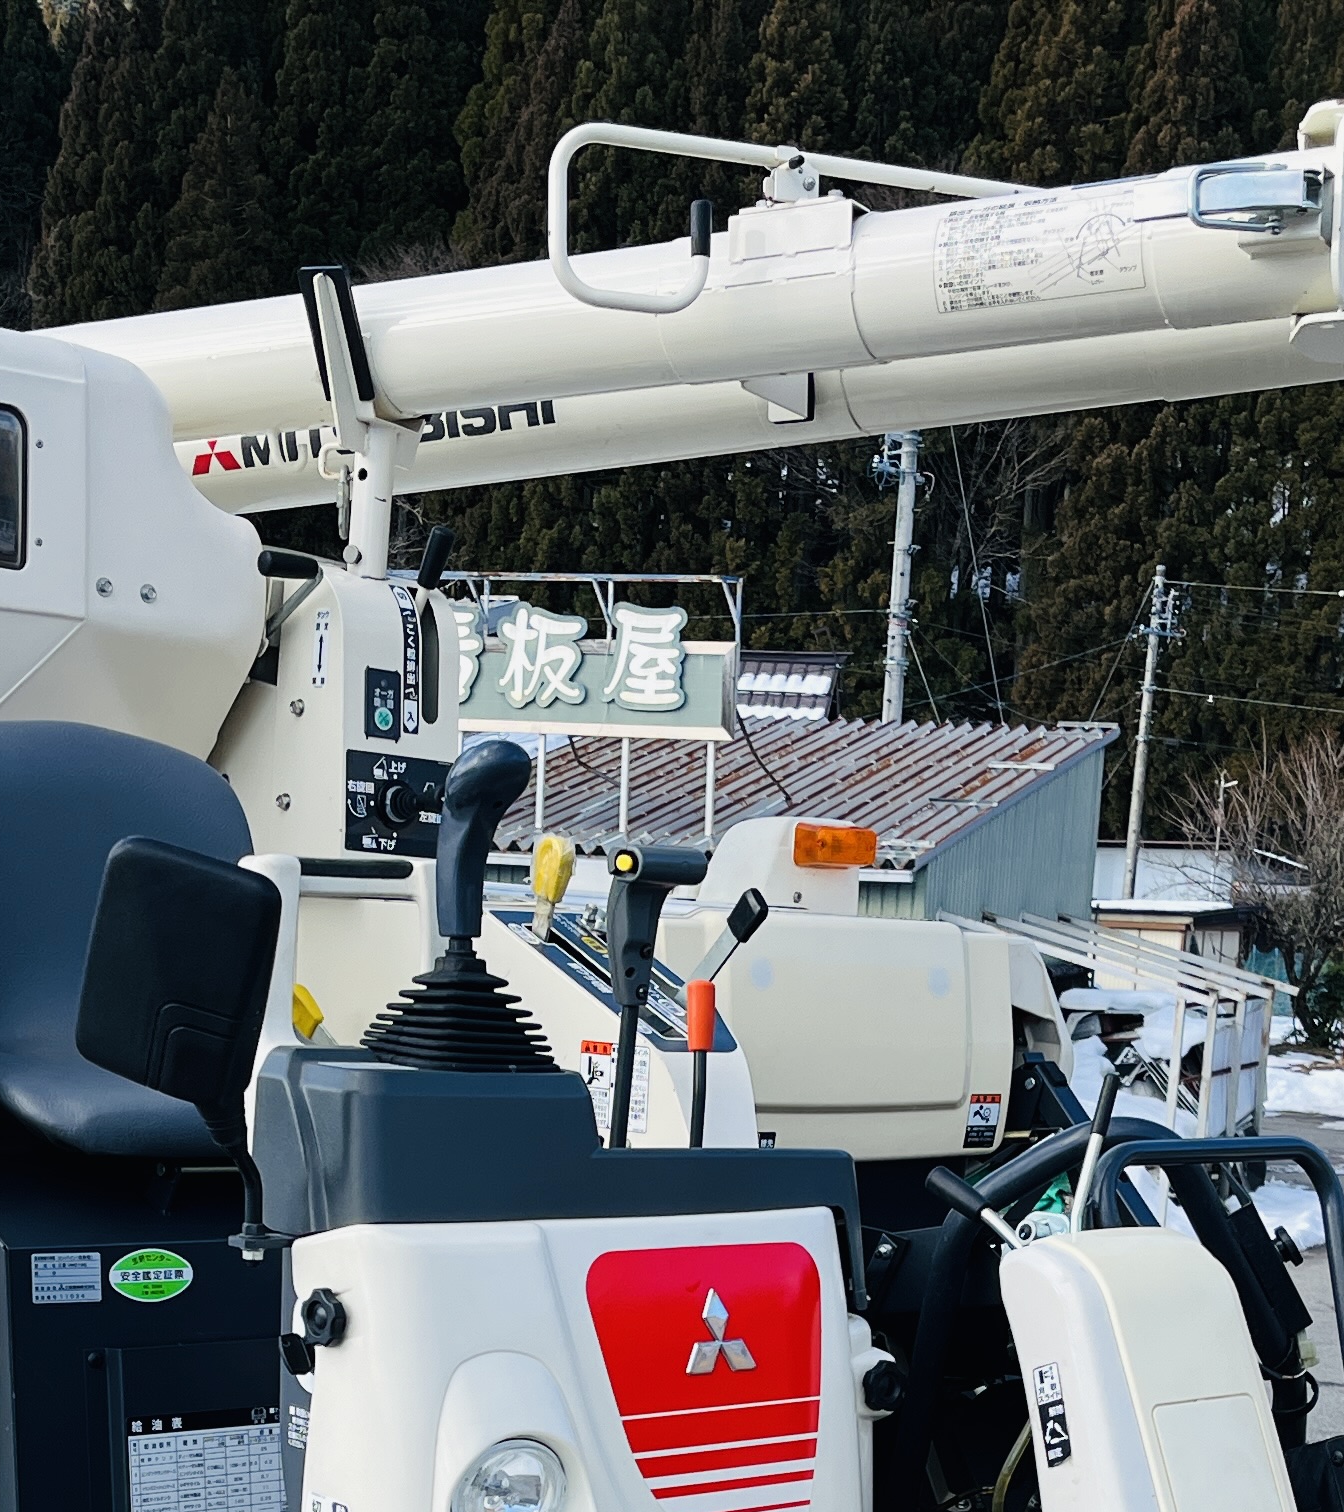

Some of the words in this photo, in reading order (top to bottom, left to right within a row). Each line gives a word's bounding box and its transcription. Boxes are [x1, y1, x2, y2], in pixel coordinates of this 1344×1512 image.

[240, 399, 557, 469] MITISHI
[389, 760, 407, 774] 上げ
[378, 838, 397, 851] 下げ
